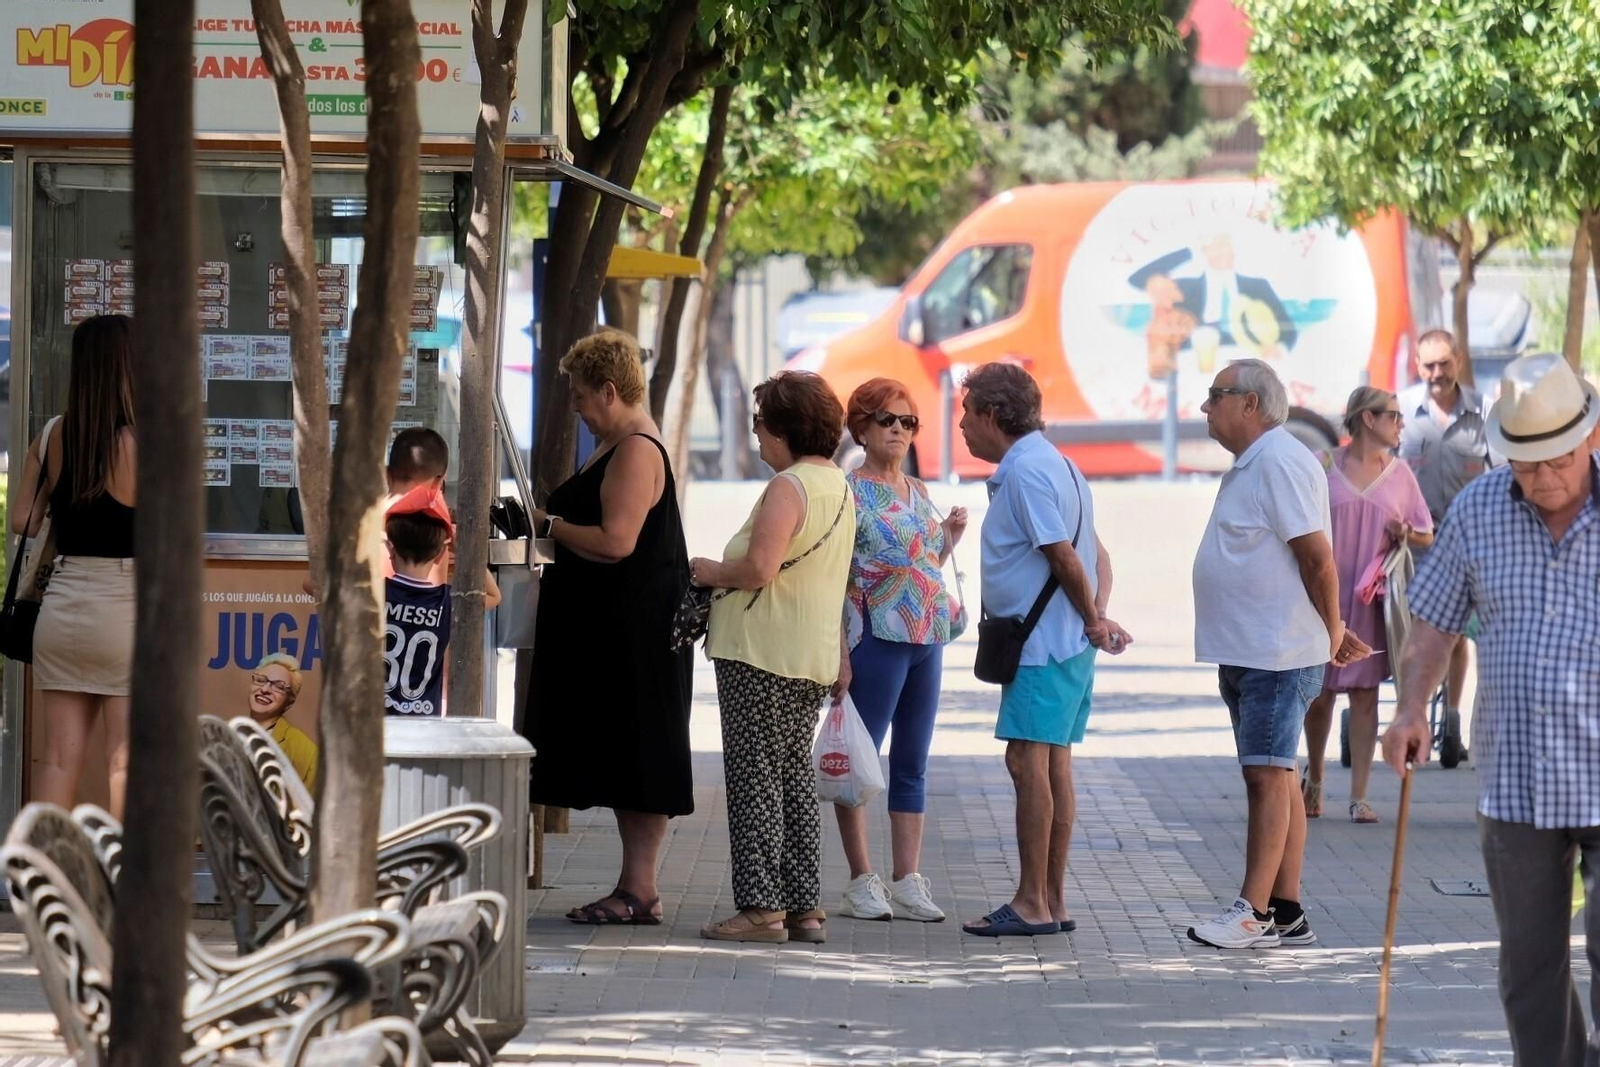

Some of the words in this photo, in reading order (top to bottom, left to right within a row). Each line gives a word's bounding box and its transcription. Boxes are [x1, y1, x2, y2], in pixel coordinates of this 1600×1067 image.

[194, 19, 227, 31] IGE
[231, 20, 257, 31] TU
[286, 21, 321, 33] CHA
[417, 22, 461, 35] CIAL
[17, 24, 71, 66] MI
[193, 56, 272, 79] ANA
[303, 65, 349, 81] STA
[0, 101, 43, 113] ONCE
[308, 97, 332, 113] dos
[336, 97, 355, 113] los
[209, 592, 225, 603] LOS
[226, 592, 243, 604] QUE
[245, 591, 274, 603] JUGÁIS
[275, 593, 283, 603] A
[284, 593, 293, 603] LA
[384, 601, 443, 628] MESSI
[207, 612, 323, 671] JUGA
